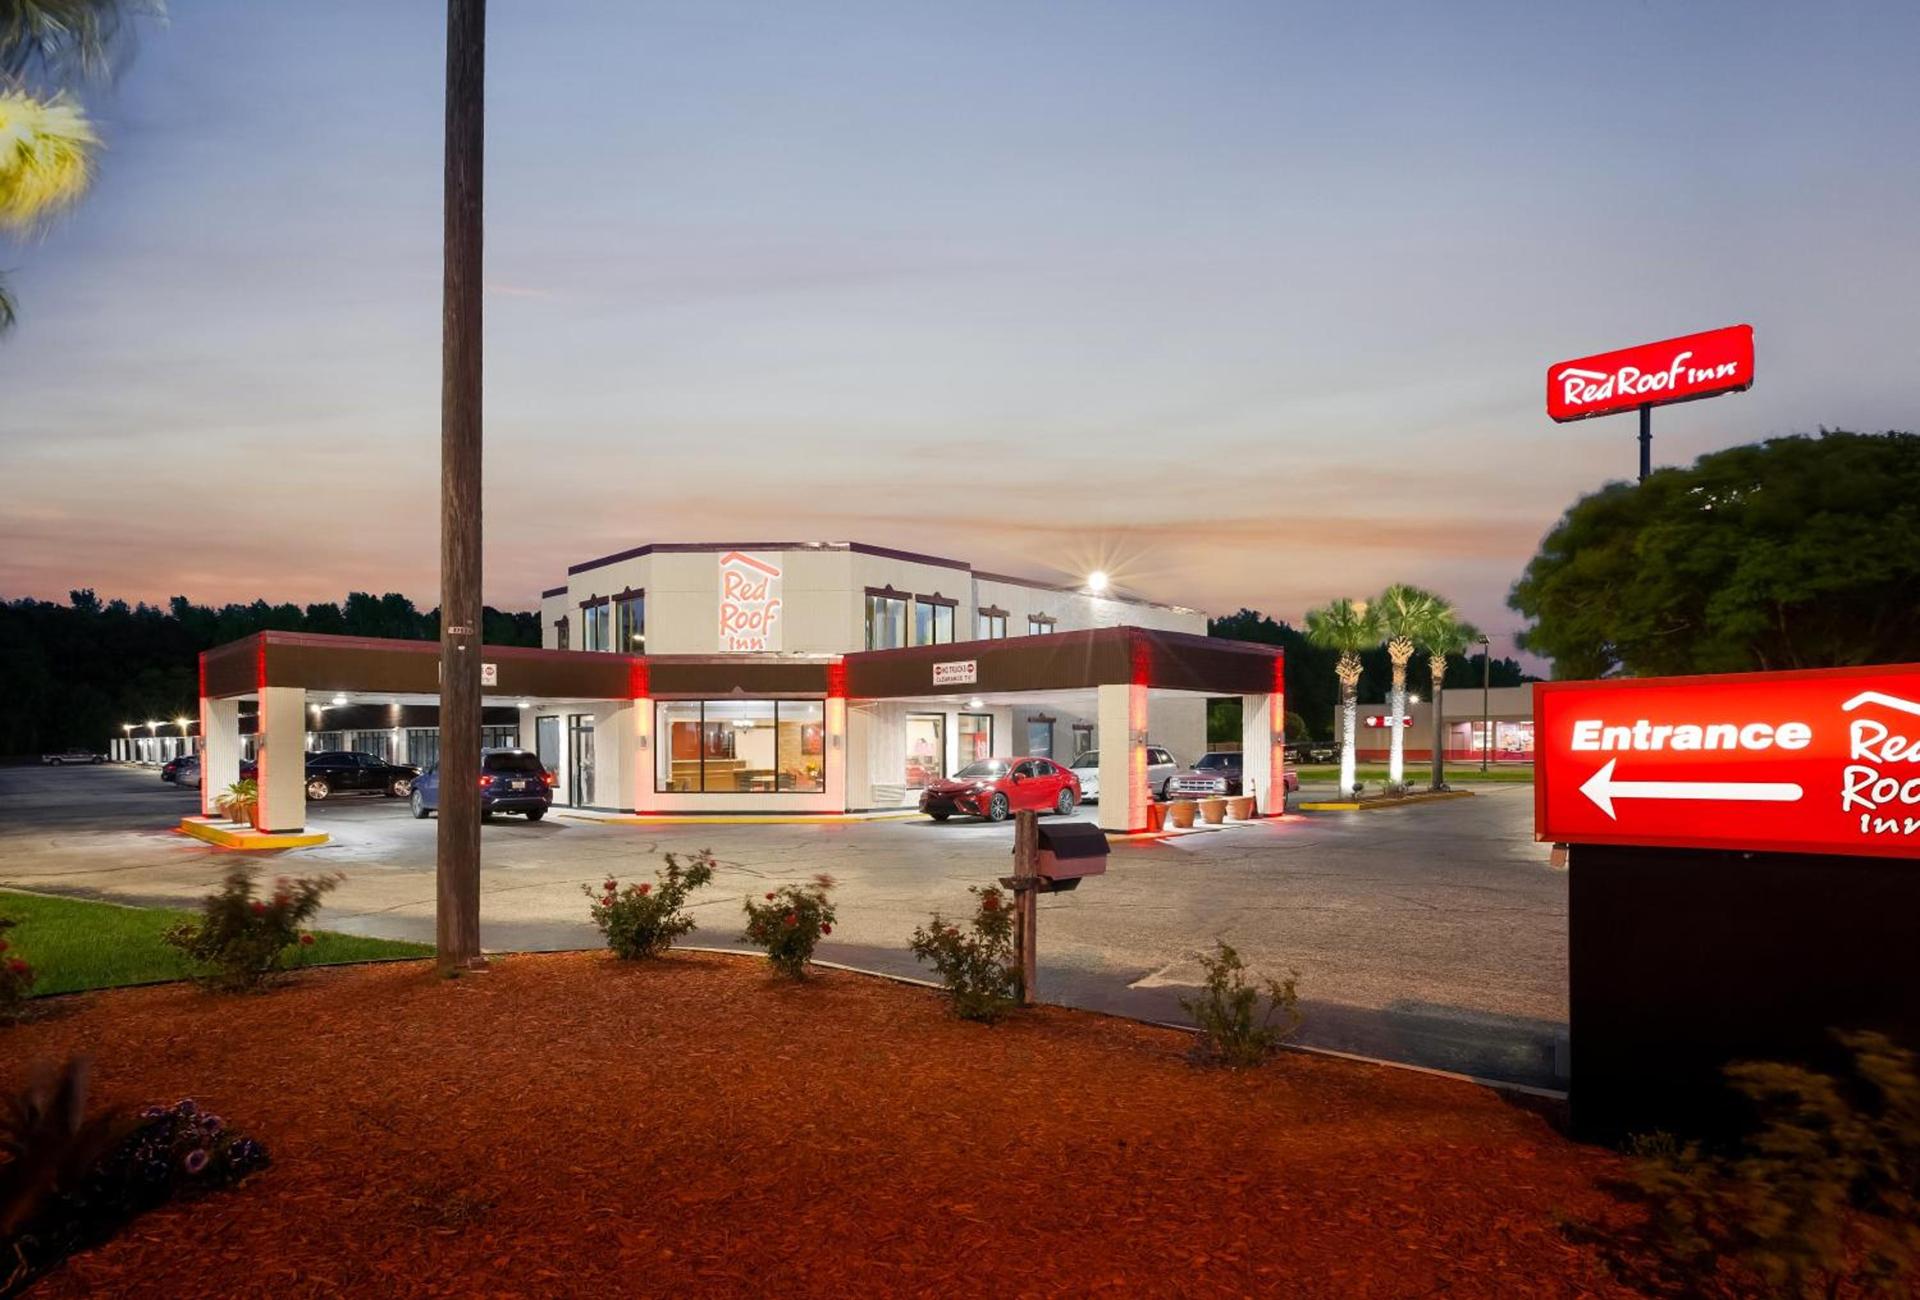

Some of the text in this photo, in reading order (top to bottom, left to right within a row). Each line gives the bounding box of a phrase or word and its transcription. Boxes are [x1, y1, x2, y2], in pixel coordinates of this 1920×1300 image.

[1564, 375, 1615, 404] Red
[1617, 351, 1693, 394] Roof
[724, 571, 769, 601] Red
[720, 599, 780, 636] Roof
[1571, 720, 1812, 751] Entrance
[1841, 765, 1920, 812] Roo
